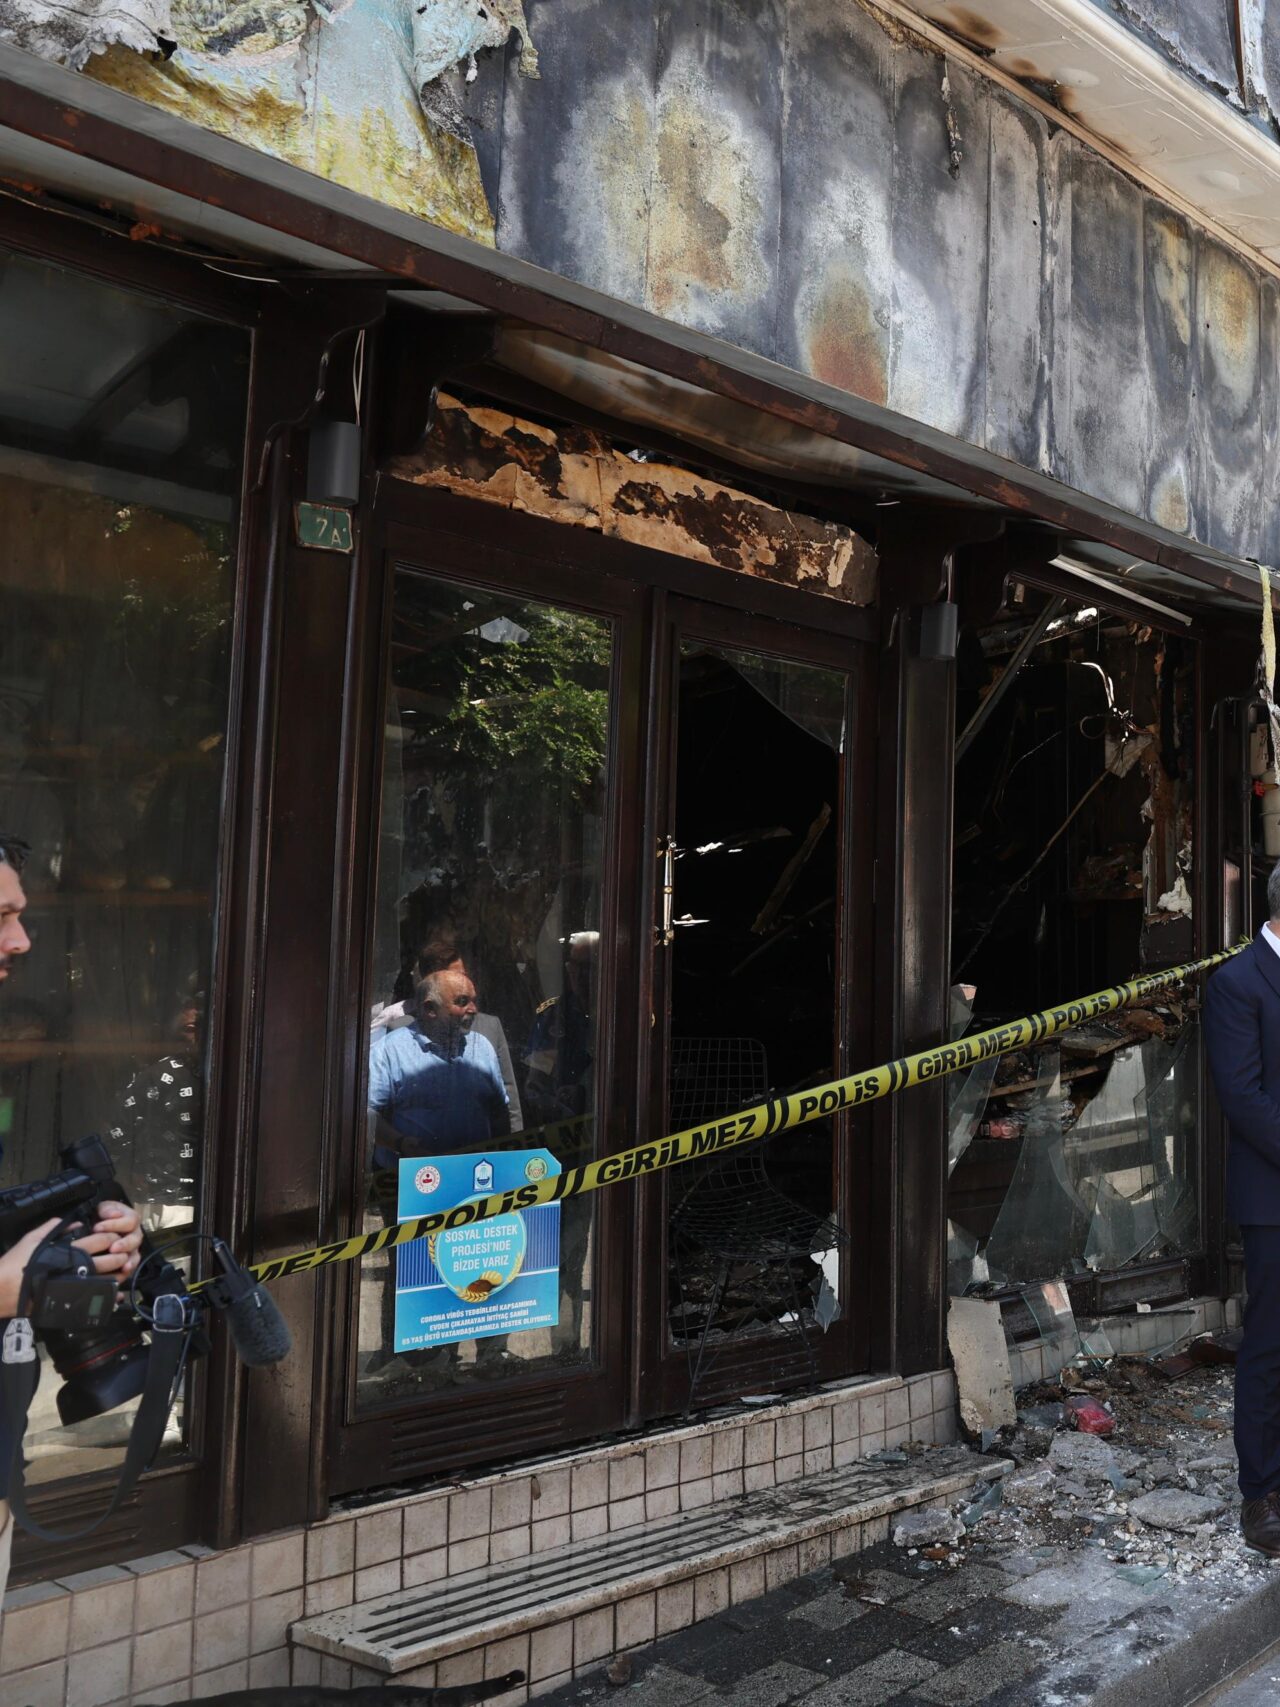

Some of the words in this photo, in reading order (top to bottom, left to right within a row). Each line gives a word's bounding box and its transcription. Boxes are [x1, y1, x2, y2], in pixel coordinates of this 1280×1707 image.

[445, 1229, 481, 1243] SOSYAL
[484, 1224, 518, 1238] DESTEK
[452, 1240, 511, 1257] PROJESİ'NDE
[453, 1258, 480, 1272] BİZDE
[482, 1254, 509, 1268] VARIZ
[420, 1313, 445, 1325] CORONA
[430, 1322, 450, 1332] EVDEN
[411, 1335, 423, 1345] YAŞ
[500, 1319, 523, 1329] DESTEK
